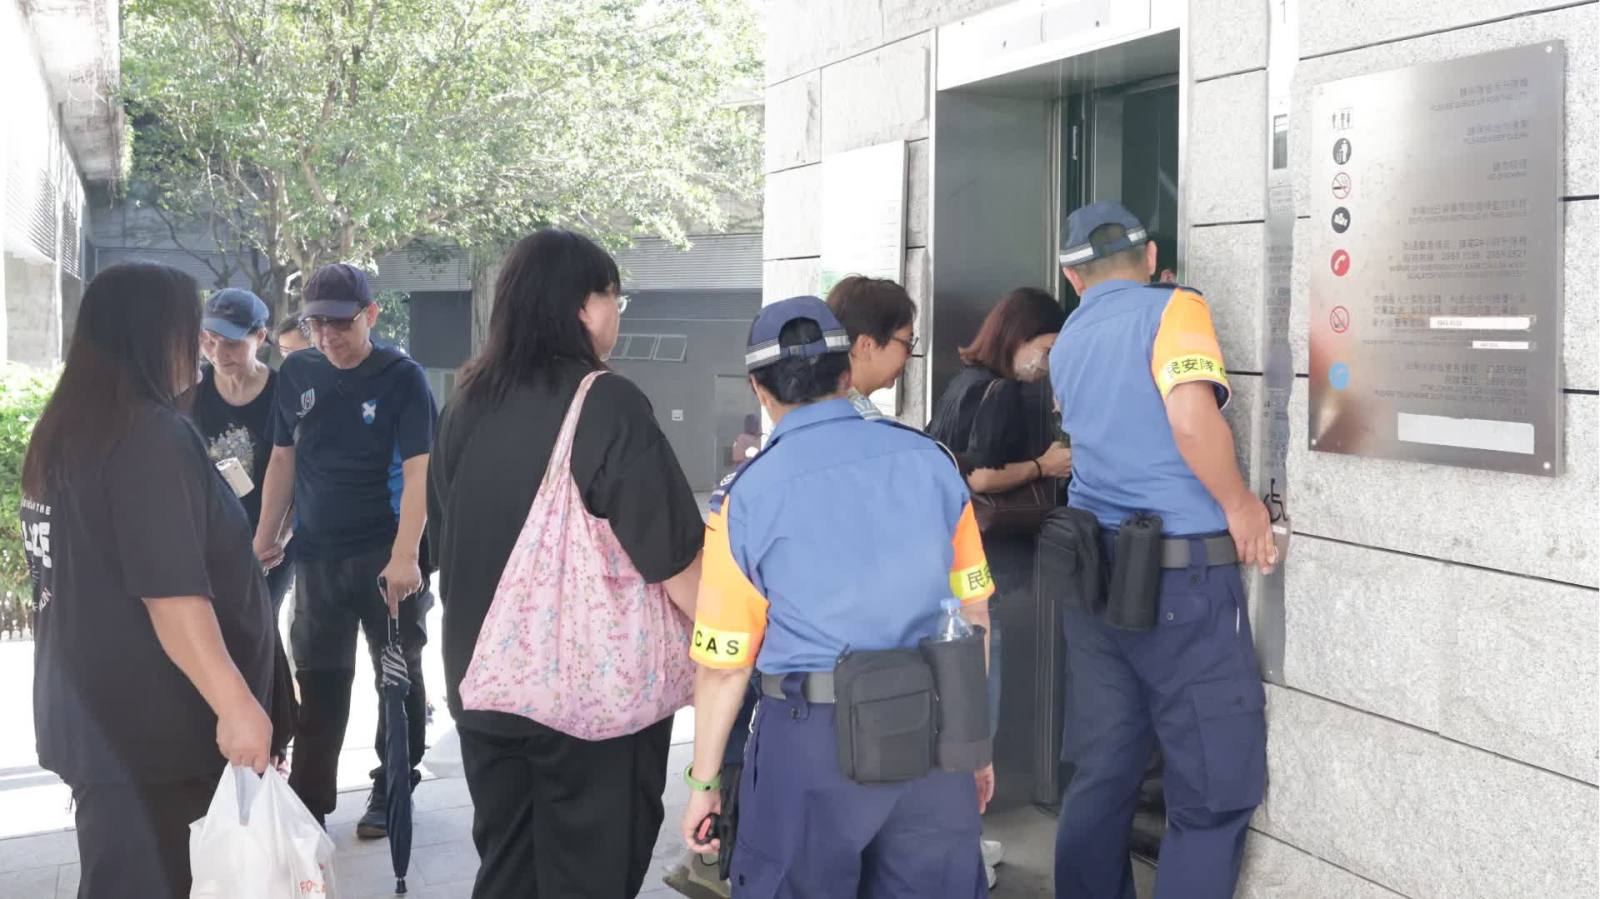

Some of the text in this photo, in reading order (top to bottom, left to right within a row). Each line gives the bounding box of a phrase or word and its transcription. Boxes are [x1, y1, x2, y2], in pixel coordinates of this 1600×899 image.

[1168, 358, 1214, 375] 民安隊
[695, 630, 740, 656] CAS
